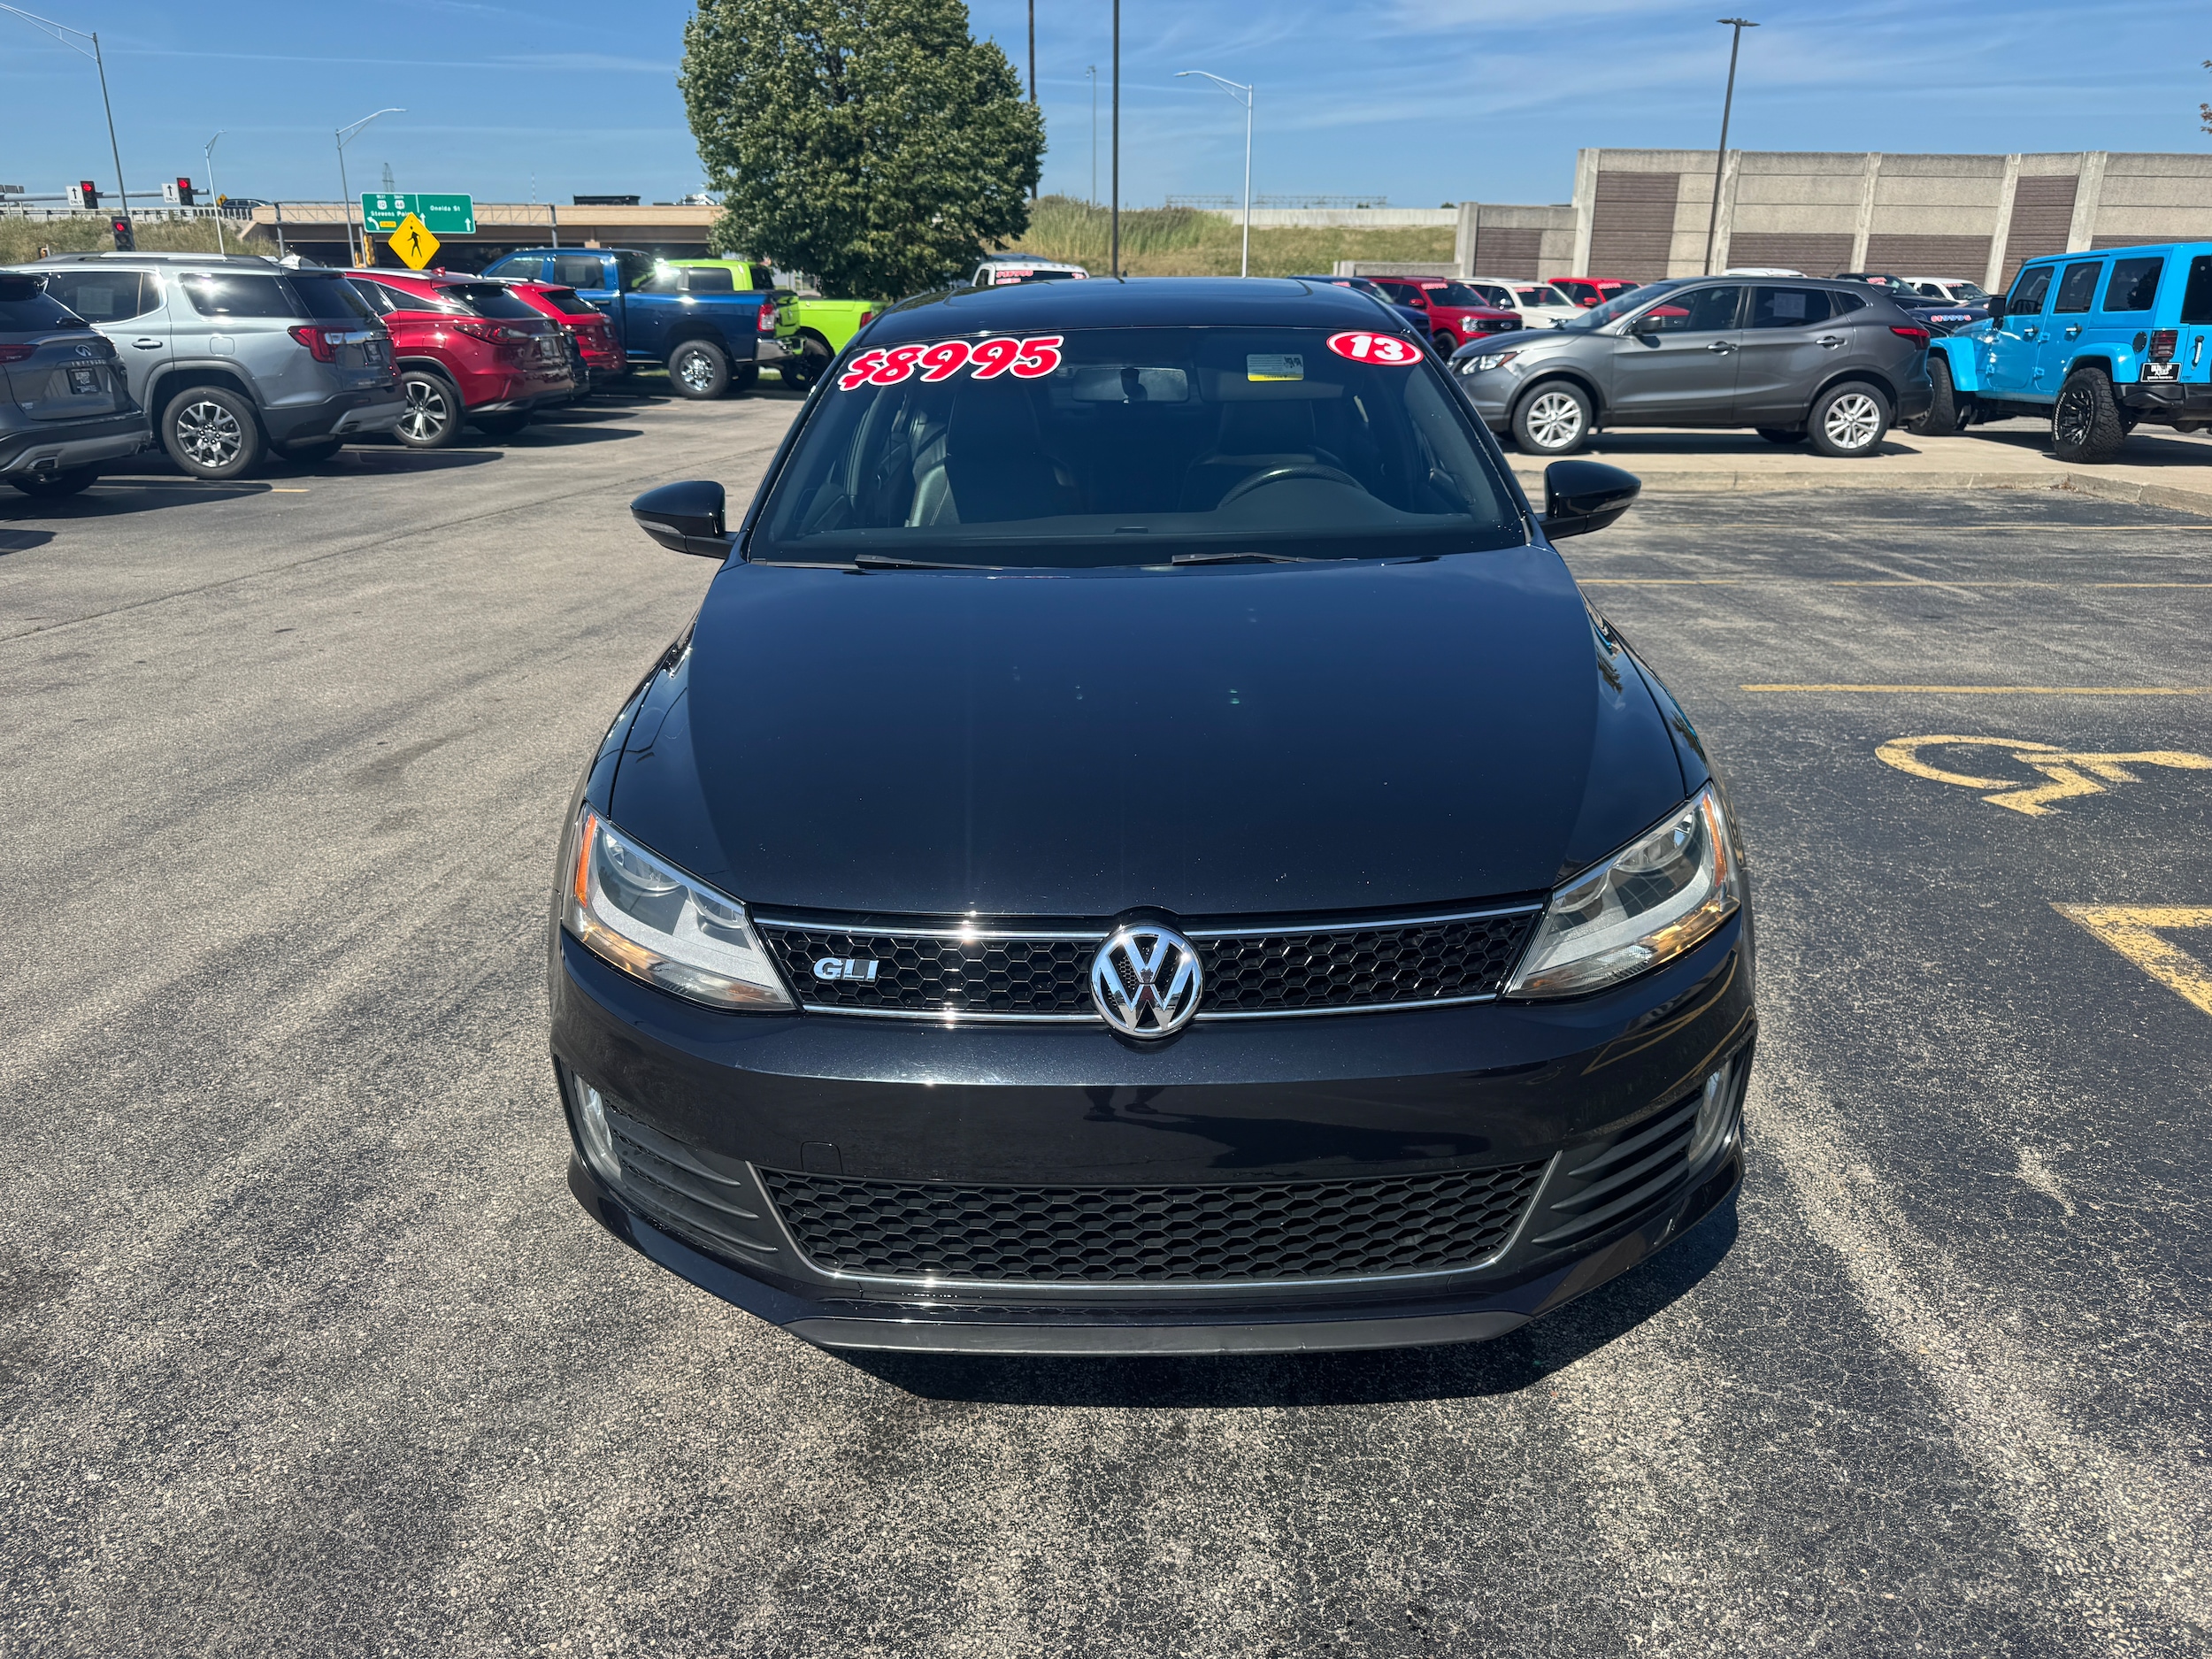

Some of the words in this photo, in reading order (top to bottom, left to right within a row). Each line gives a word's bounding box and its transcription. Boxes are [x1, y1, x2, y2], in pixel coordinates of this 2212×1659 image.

[1350, 335, 1404, 361] 13
[838, 335, 1064, 391] $8995
[813, 956, 879, 982] GLI
